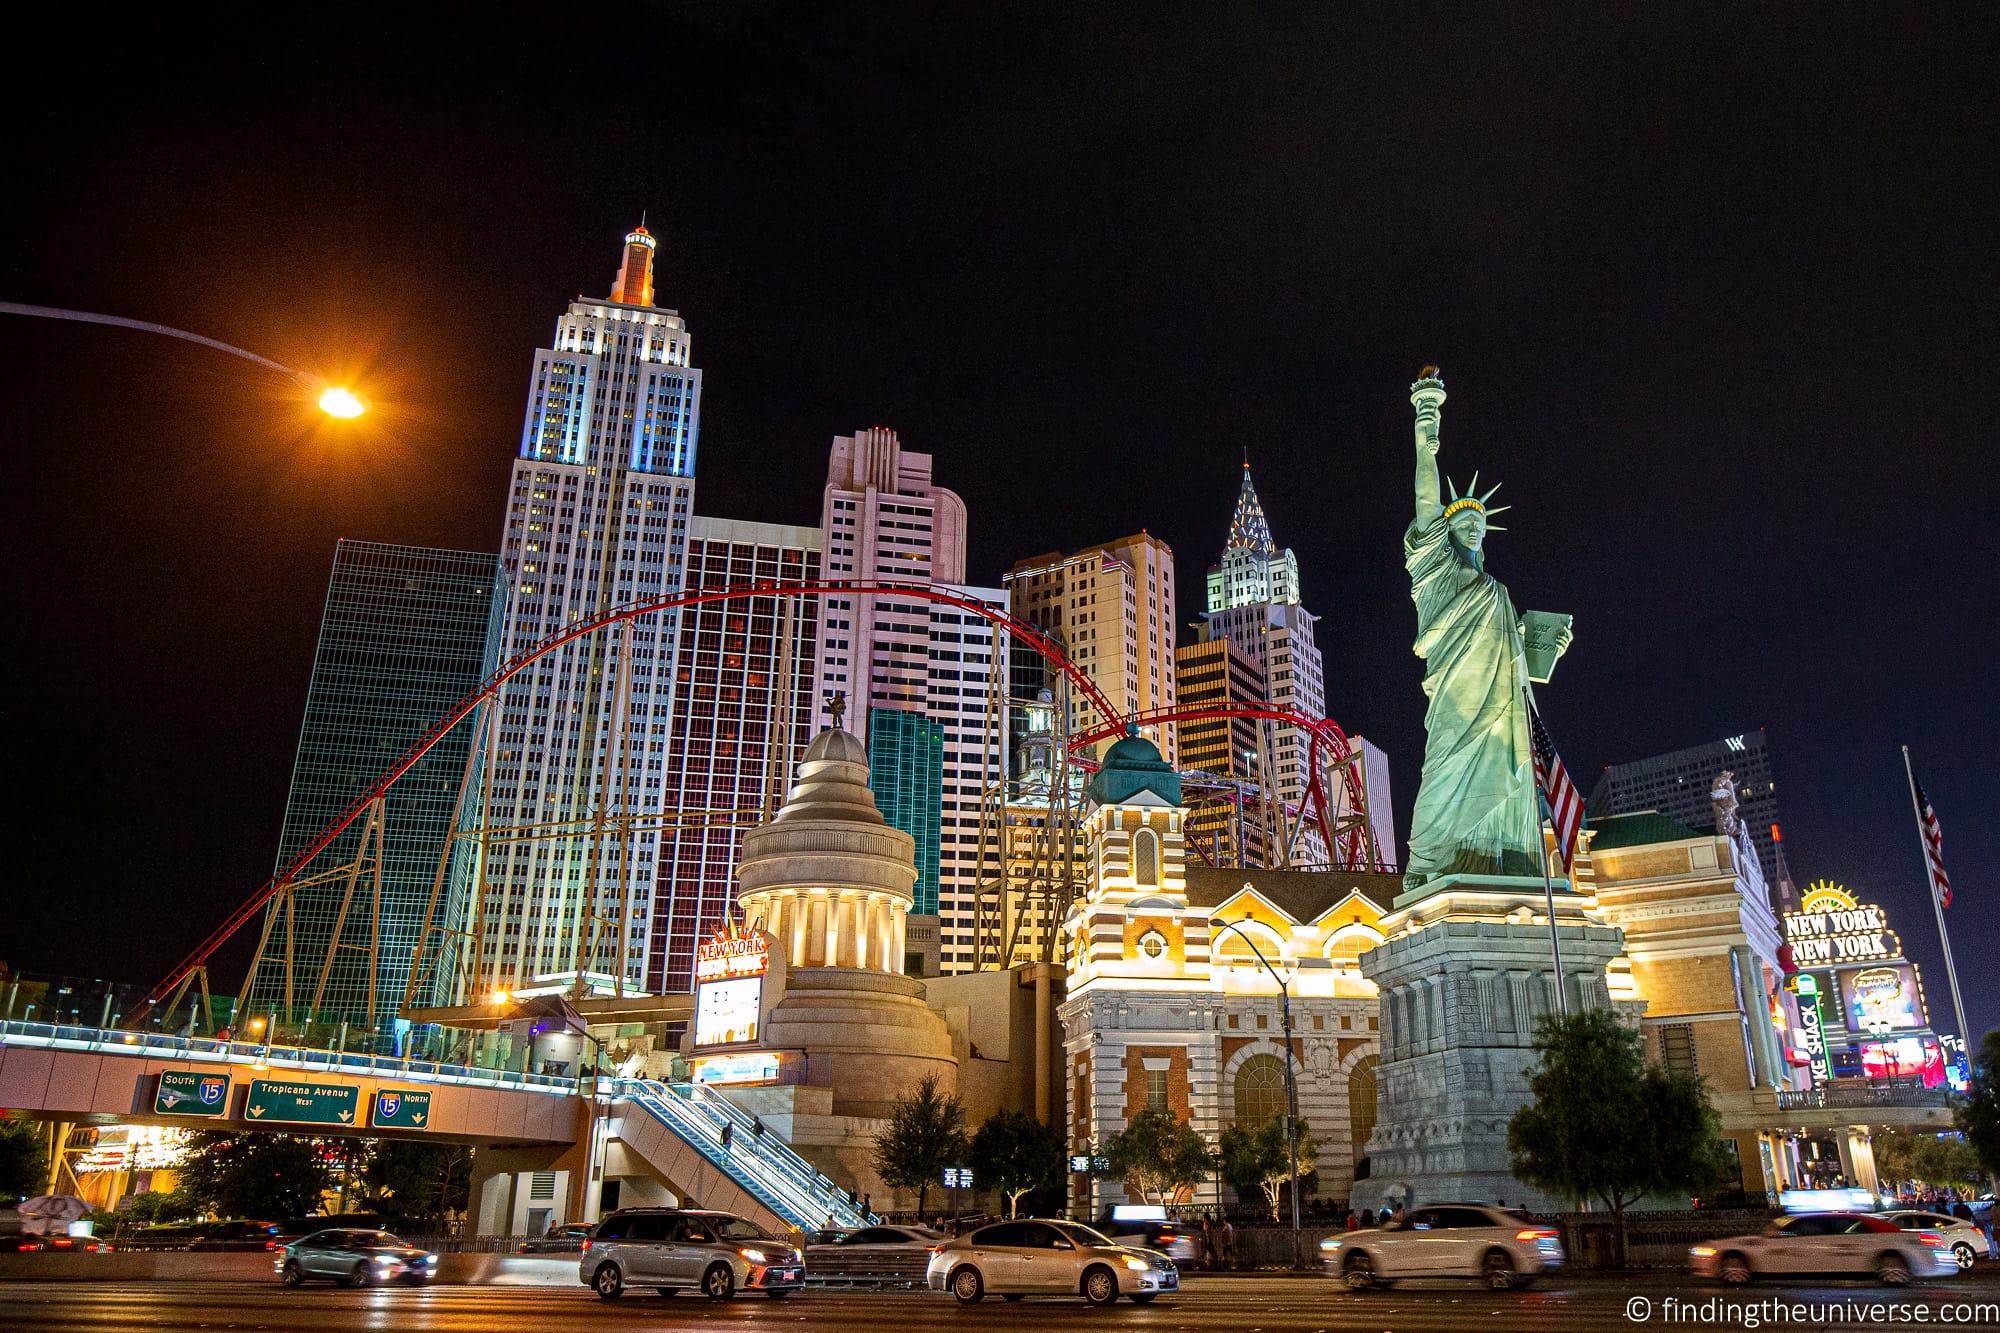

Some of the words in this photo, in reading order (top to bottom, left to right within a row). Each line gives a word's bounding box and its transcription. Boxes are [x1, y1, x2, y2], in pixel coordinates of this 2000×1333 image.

[1785, 914, 1826, 937] NEW
[1829, 908, 1881, 933] YORK
[699, 943, 727, 959] NEW
[730, 939, 763, 955] YORK
[1792, 938, 1831, 961] NEW
[1833, 934, 1887, 957] YORK
[1800, 1004, 1824, 1055] SHACK
[165, 1075, 195, 1085] SOUTH
[204, 1084, 219, 1100] 15
[261, 1083, 310, 1095] Tropicana
[314, 1087, 349, 1098] Avenue
[404, 1094, 428, 1103] NORTH
[384, 1099, 396, 1113] 15
